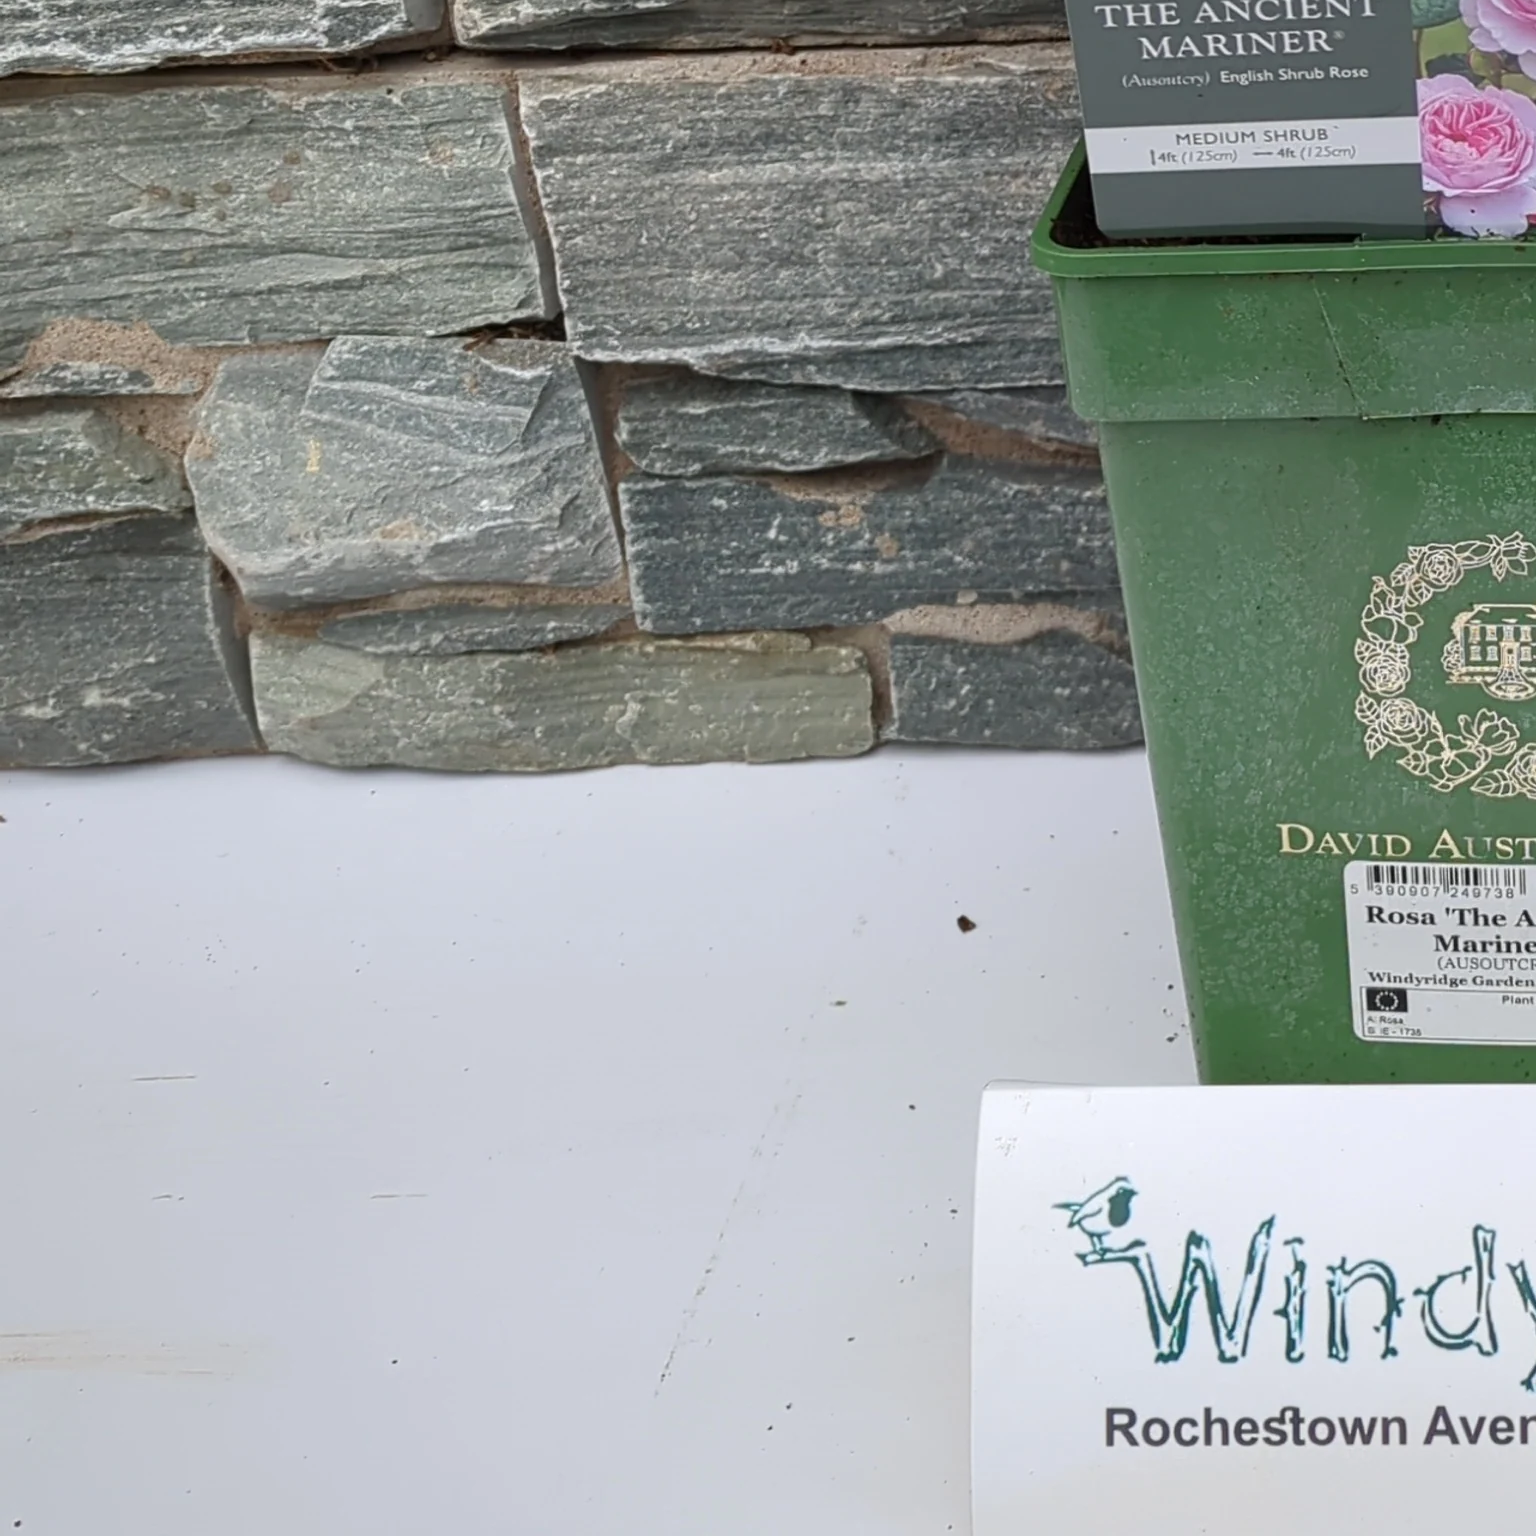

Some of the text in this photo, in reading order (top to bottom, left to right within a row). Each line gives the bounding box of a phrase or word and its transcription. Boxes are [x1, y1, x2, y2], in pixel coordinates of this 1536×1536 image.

[1094, 2, 1181, 27] THE
[1220, 70, 1273, 85] English
[1278, 66, 1324, 81] Shrub
[1329, 66, 1369, 79] Rose
[1176, 128, 1329, 145] MEDIUM SHRUB
[1181, 149, 1238, 164] (125cm)
[1276, 147, 1296, 159] 4ft
[1300, 145, 1356, 161] (125cm)
[1276, 823, 1411, 857] DAVID
[1350, 883, 1515, 899] 5 390907 249738
[1365, 905, 1436, 926] Rosa
[1445, 907, 1507, 927] 'The
[1368, 971, 1468, 988] Windyridge
[1472, 975, 1536, 987] Garden
[1501, 995, 1534, 1005] Plant
[1105, 1406, 1408, 1447] Rochestown
